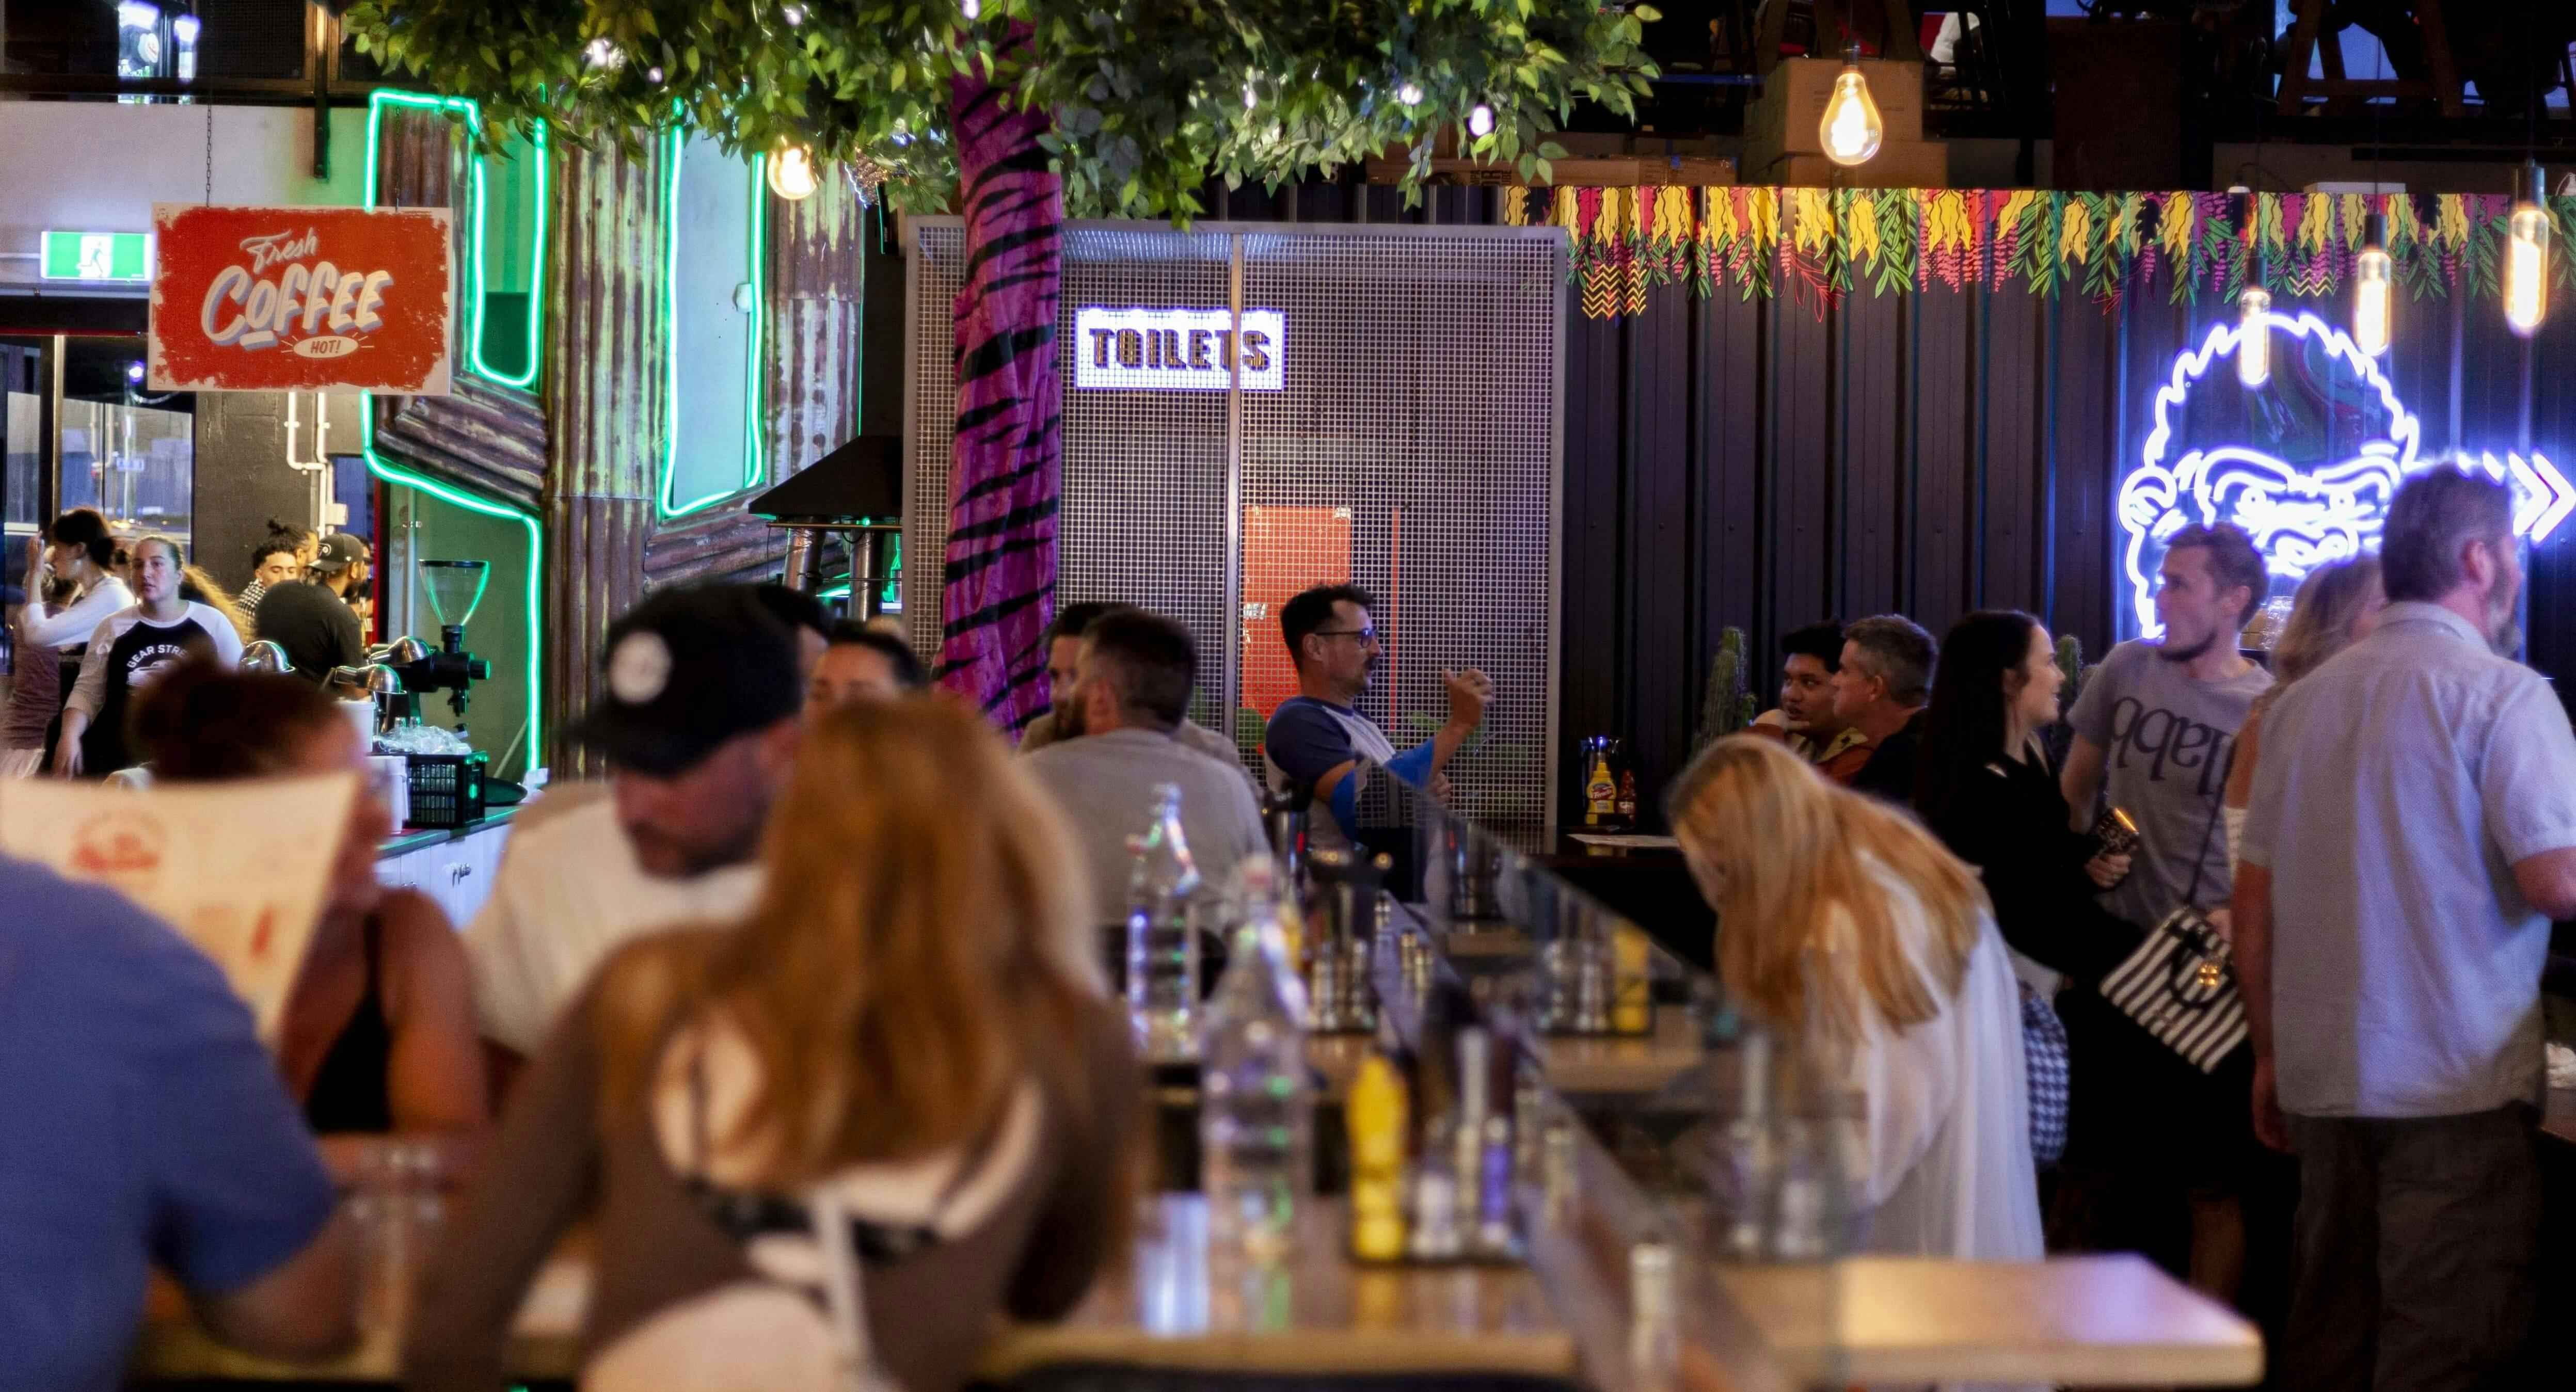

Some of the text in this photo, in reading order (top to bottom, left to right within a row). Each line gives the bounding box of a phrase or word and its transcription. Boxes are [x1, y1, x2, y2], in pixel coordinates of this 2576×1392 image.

[239, 227, 317, 275] Fresh
[310, 340, 342, 354] HOT!
[1089, 328, 1271, 372] TOILETS
[126, 646, 154, 668] GEAR
